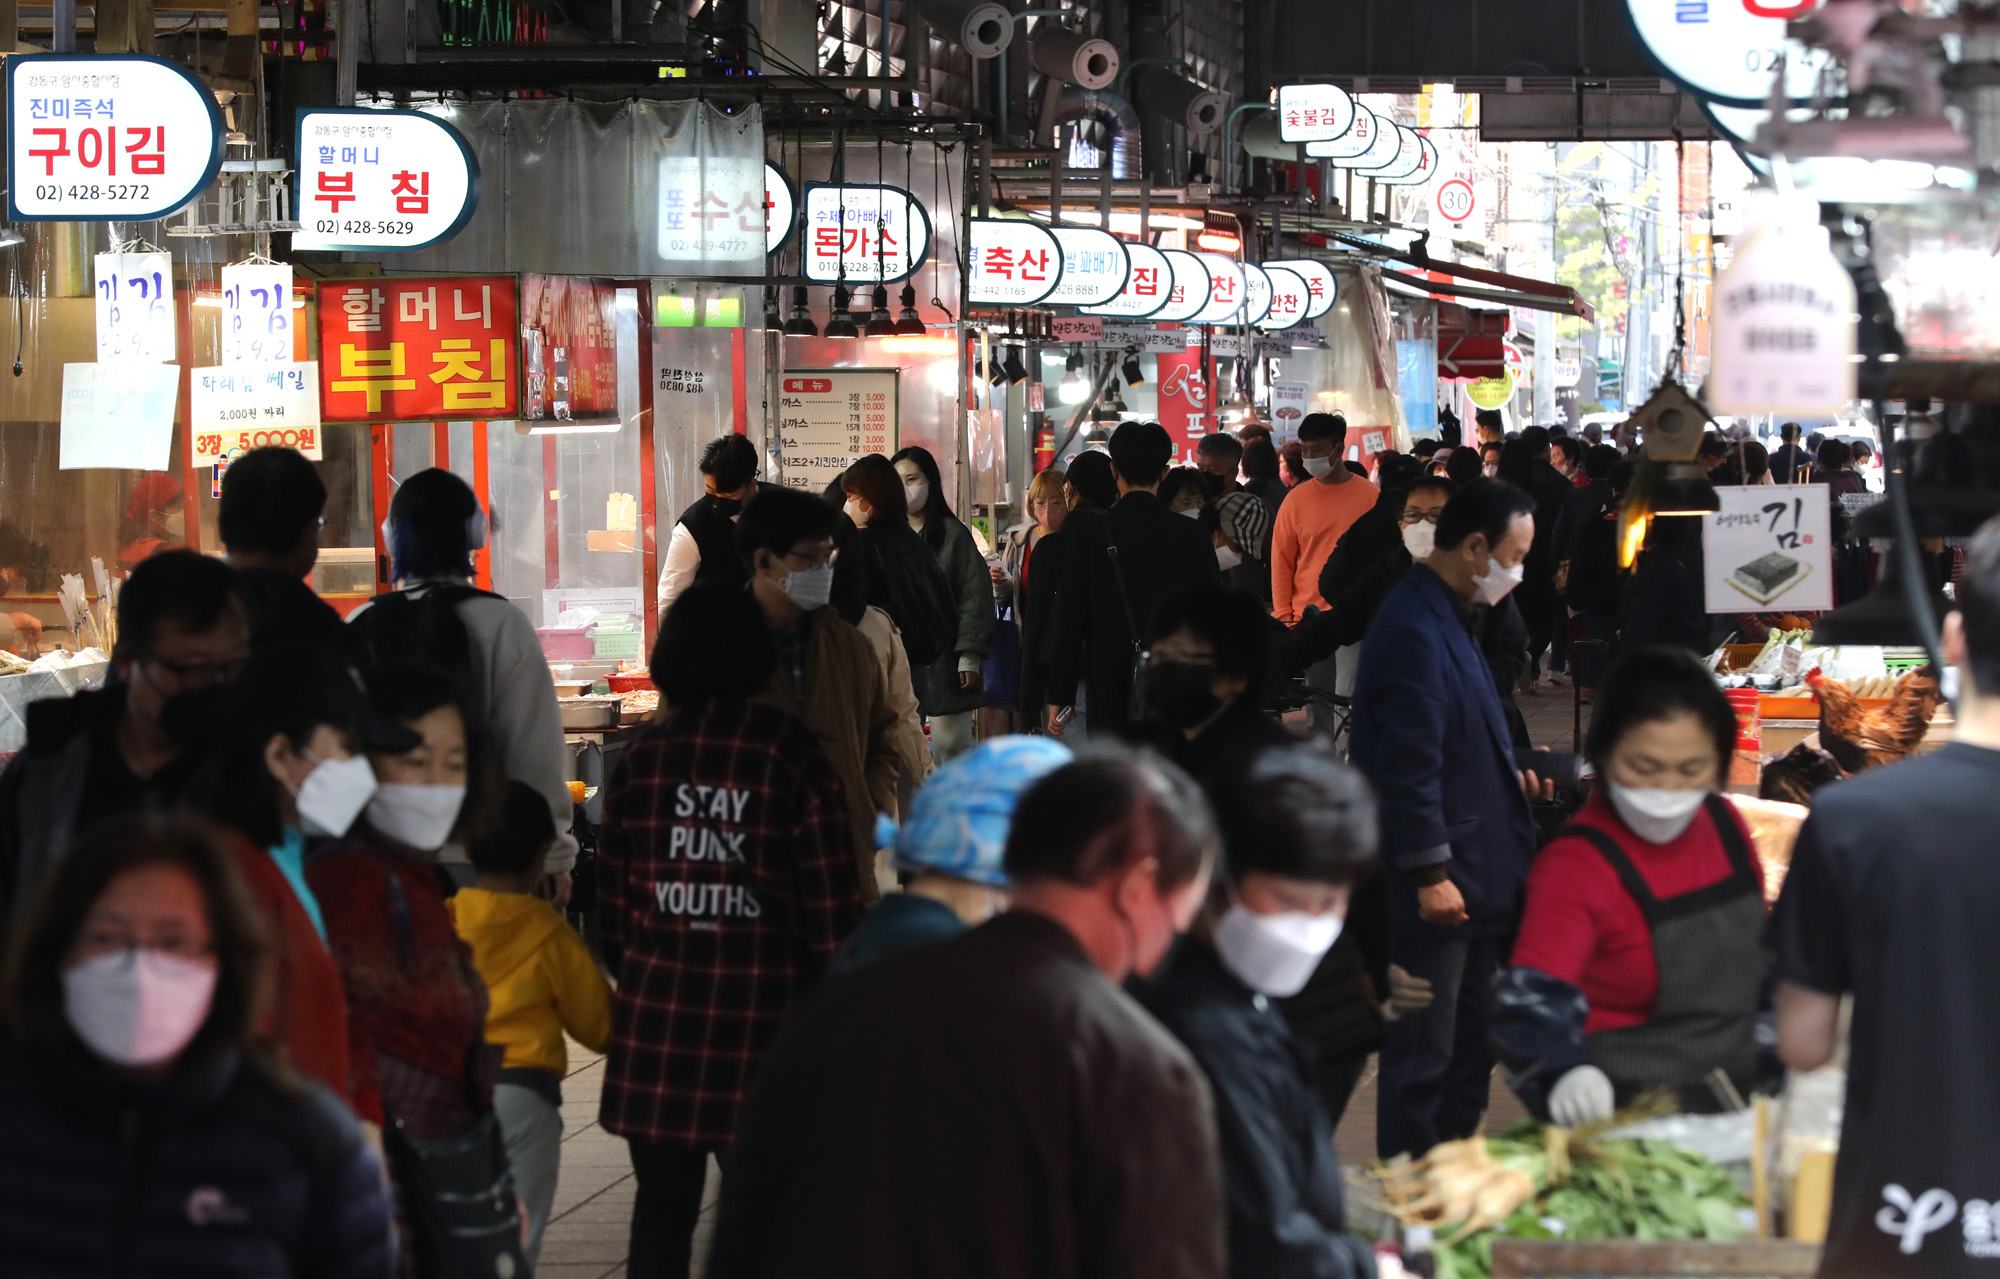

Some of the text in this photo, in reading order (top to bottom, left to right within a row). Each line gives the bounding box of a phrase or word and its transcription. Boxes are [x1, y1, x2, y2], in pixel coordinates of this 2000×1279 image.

[29, 75, 57, 87] 강동구
[30, 98, 114, 119] 진미즉석
[315, 126, 339, 136] 강동구
[29, 126, 165, 176] 구이김
[319, 145, 379, 165] 할머니
[36, 184, 150, 202] 02) 428-5272
[1444, 191, 1468, 211] 30
[690, 190, 775, 233] 수산
[317, 220, 414, 235] 02) 428-5629
[815, 227, 898, 258] 돈가스
[984, 246, 1049, 281] 축산
[342, 284, 492, 333] 할머니
[331, 338, 506, 413] 부침
[848, 393, 885, 402] 3장 5,000
[848, 403, 886, 411] 7장 10,000
[862, 423, 886, 432] 10,000
[866, 414, 885, 422] 5,000
[197, 434, 222, 456] 3장
[862, 445, 886, 453] 10,000
[865, 435, 885, 444] 3,000
[1762, 498, 1802, 549] 김
[675, 783, 750, 823] STAY
[668, 826, 746, 864] PUNK
[655, 880, 761, 918] YOUTHS
